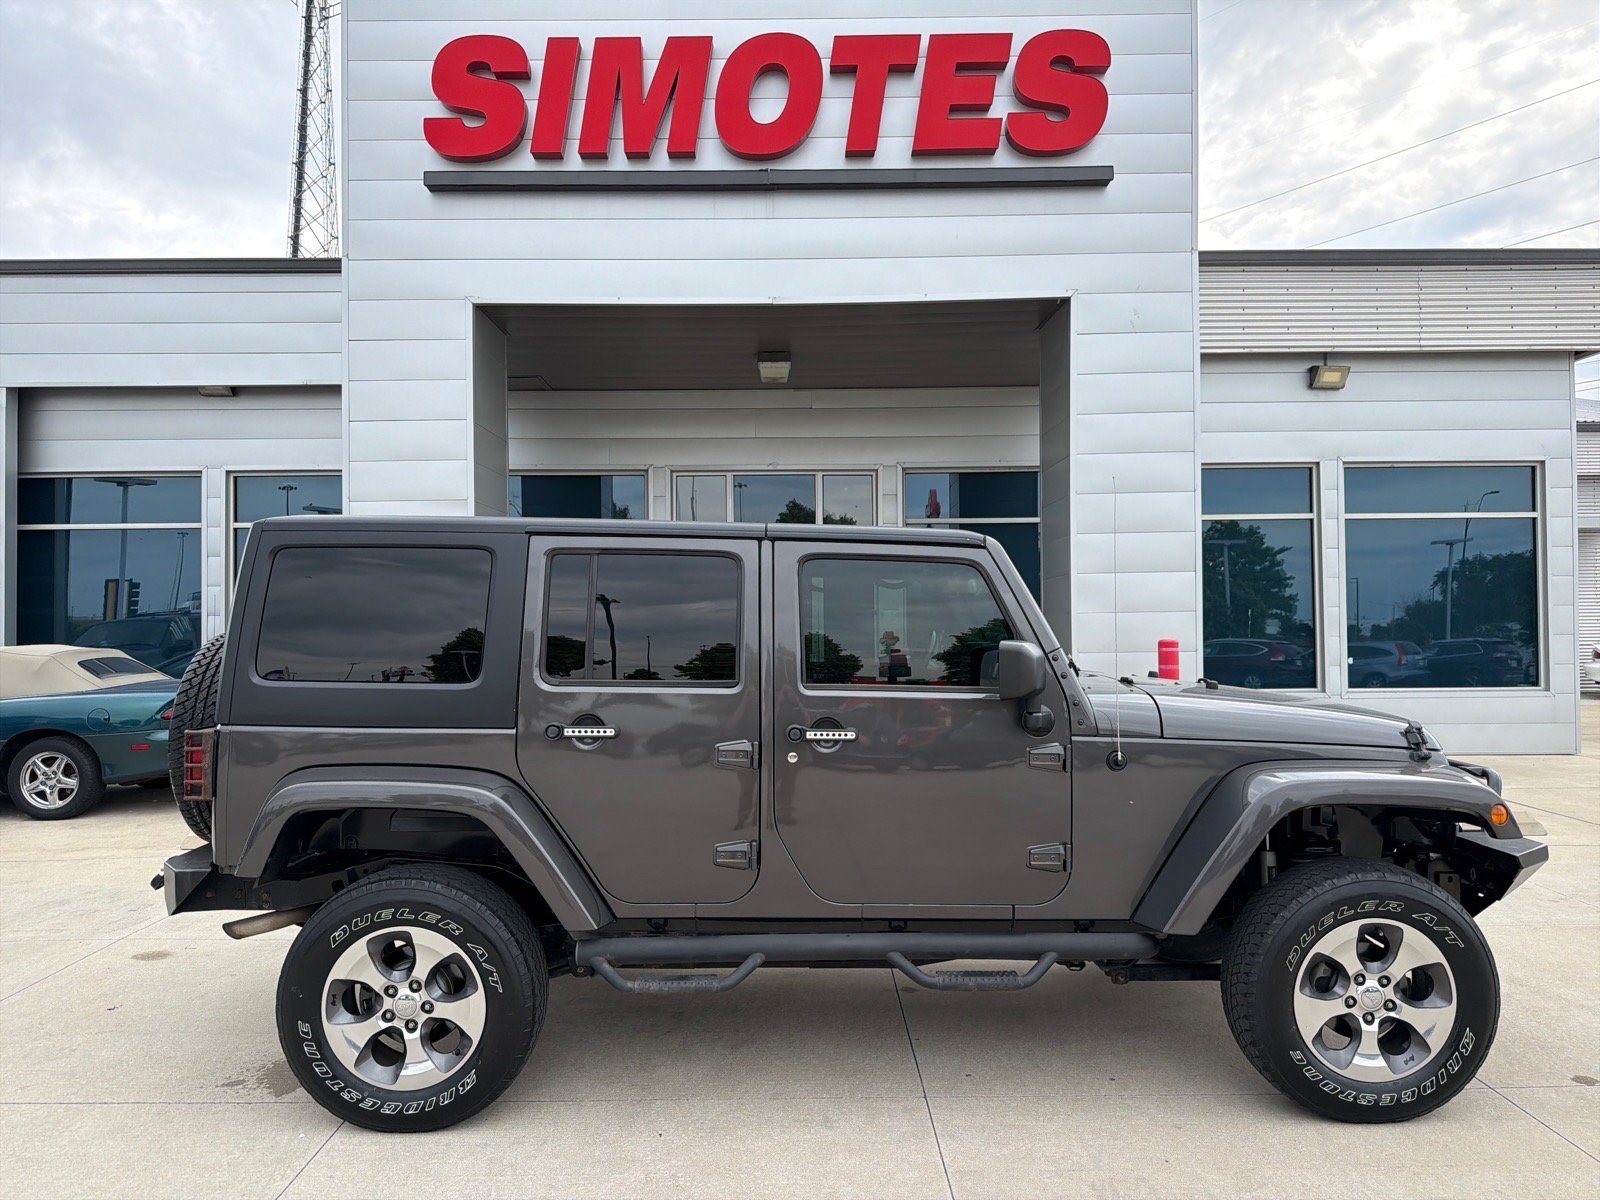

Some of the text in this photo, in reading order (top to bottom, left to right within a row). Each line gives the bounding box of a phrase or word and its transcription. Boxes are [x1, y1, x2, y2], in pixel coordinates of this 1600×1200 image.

[423, 29, 1112, 163] SIMOTES
[331, 908, 503, 993] DUELER A/T
[1285, 900, 1465, 972] DUELER A/T
[297, 1020, 477, 1115] BRIDGESTONE
[1289, 1027, 1476, 1107] BRIDGESTONE
